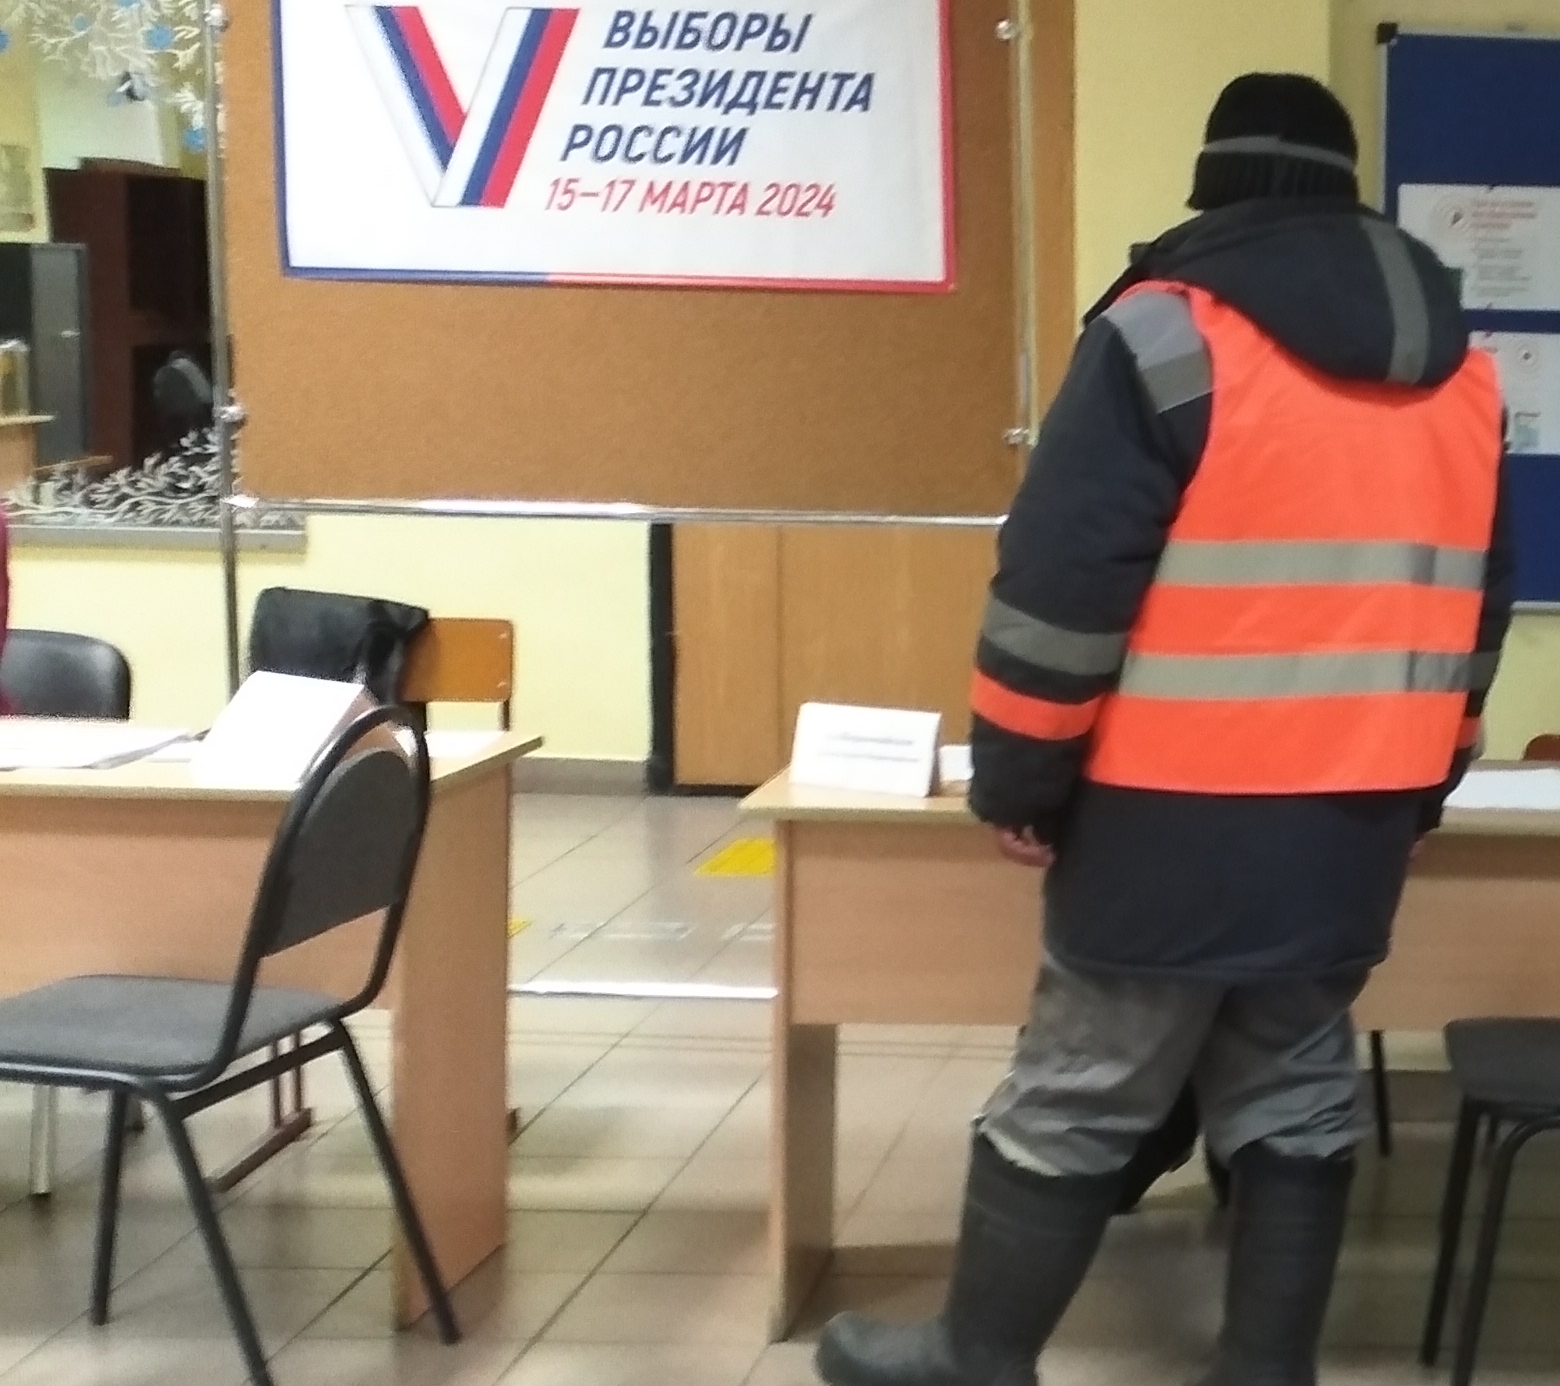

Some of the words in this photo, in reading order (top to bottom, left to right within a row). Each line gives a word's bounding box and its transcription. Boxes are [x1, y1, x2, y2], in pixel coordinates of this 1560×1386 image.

[603, 10, 815, 55] ВЫБОРЫ
[582, 67, 878, 118] ПРЕЗИДЕНТА
[561, 124, 751, 168] РОССИИ
[640, 181, 751, 217] МАРТА
[755, 182, 838, 220] 2024
